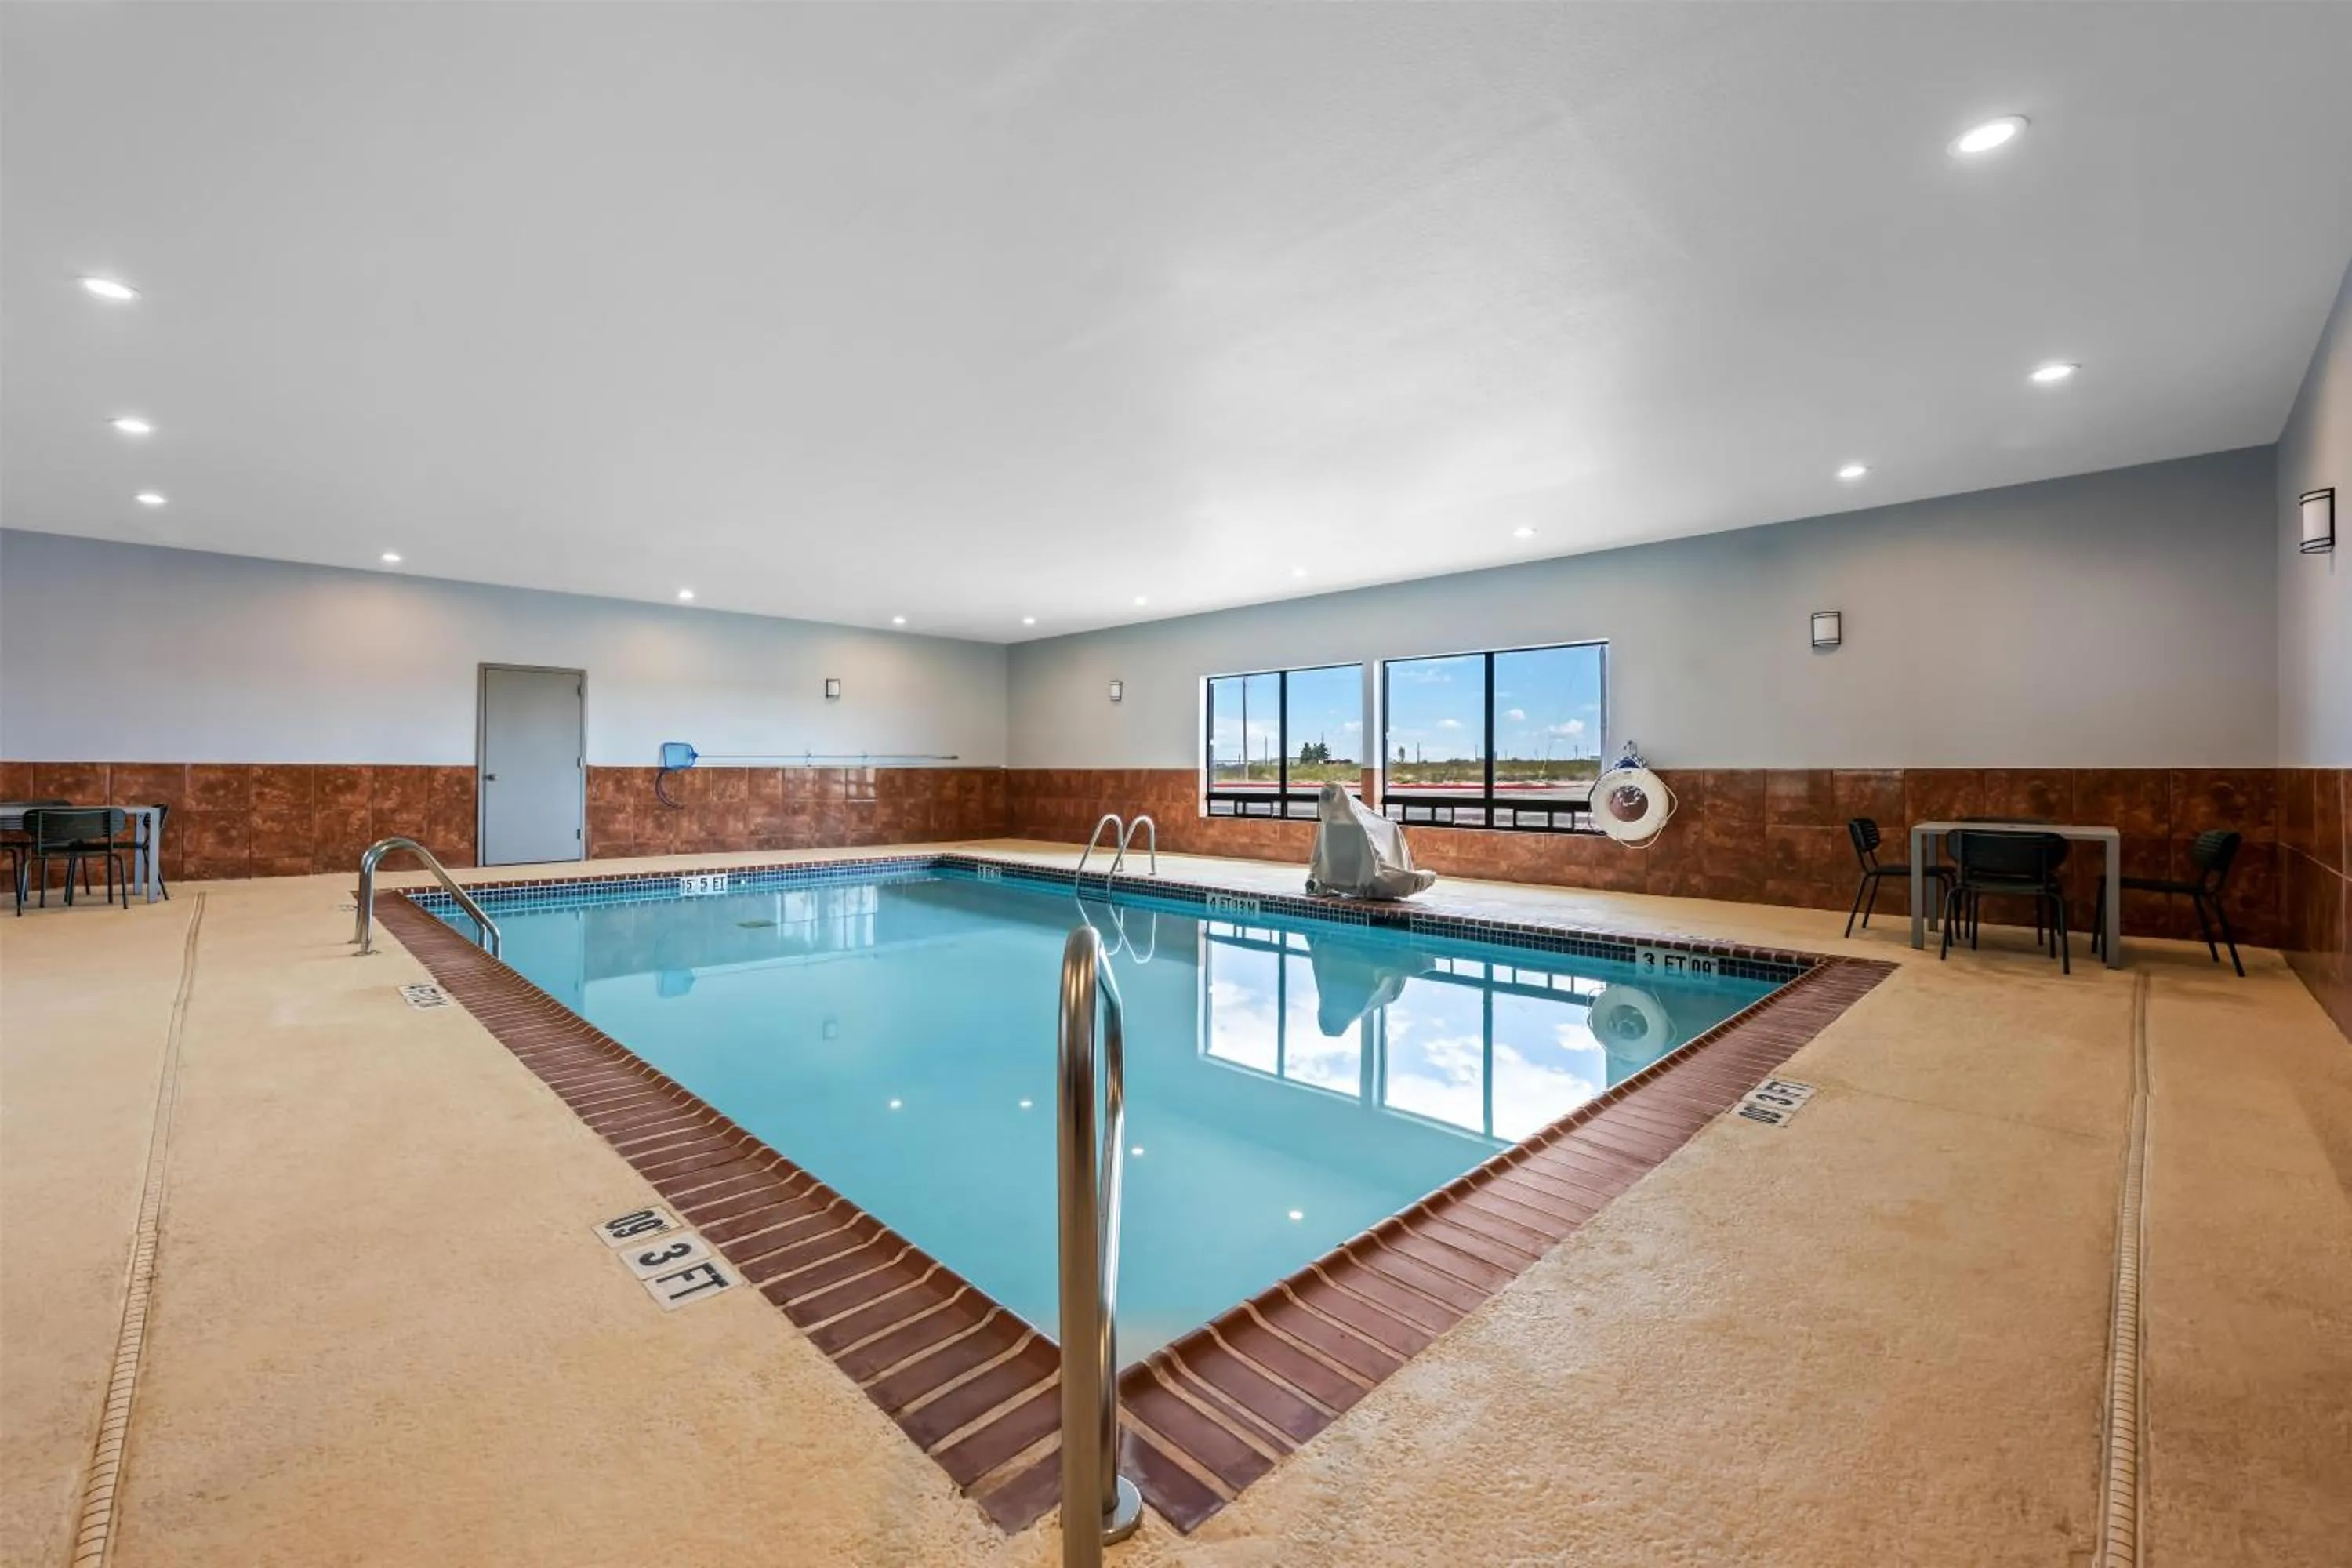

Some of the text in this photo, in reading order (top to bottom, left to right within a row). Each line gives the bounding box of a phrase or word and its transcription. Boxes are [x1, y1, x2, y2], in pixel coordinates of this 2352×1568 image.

[1643, 953, 1655, 966] 3
[1664, 955, 1686, 971] FT
[638, 1243, 691, 1266] 3
[655, 1262, 728, 1301] FT
